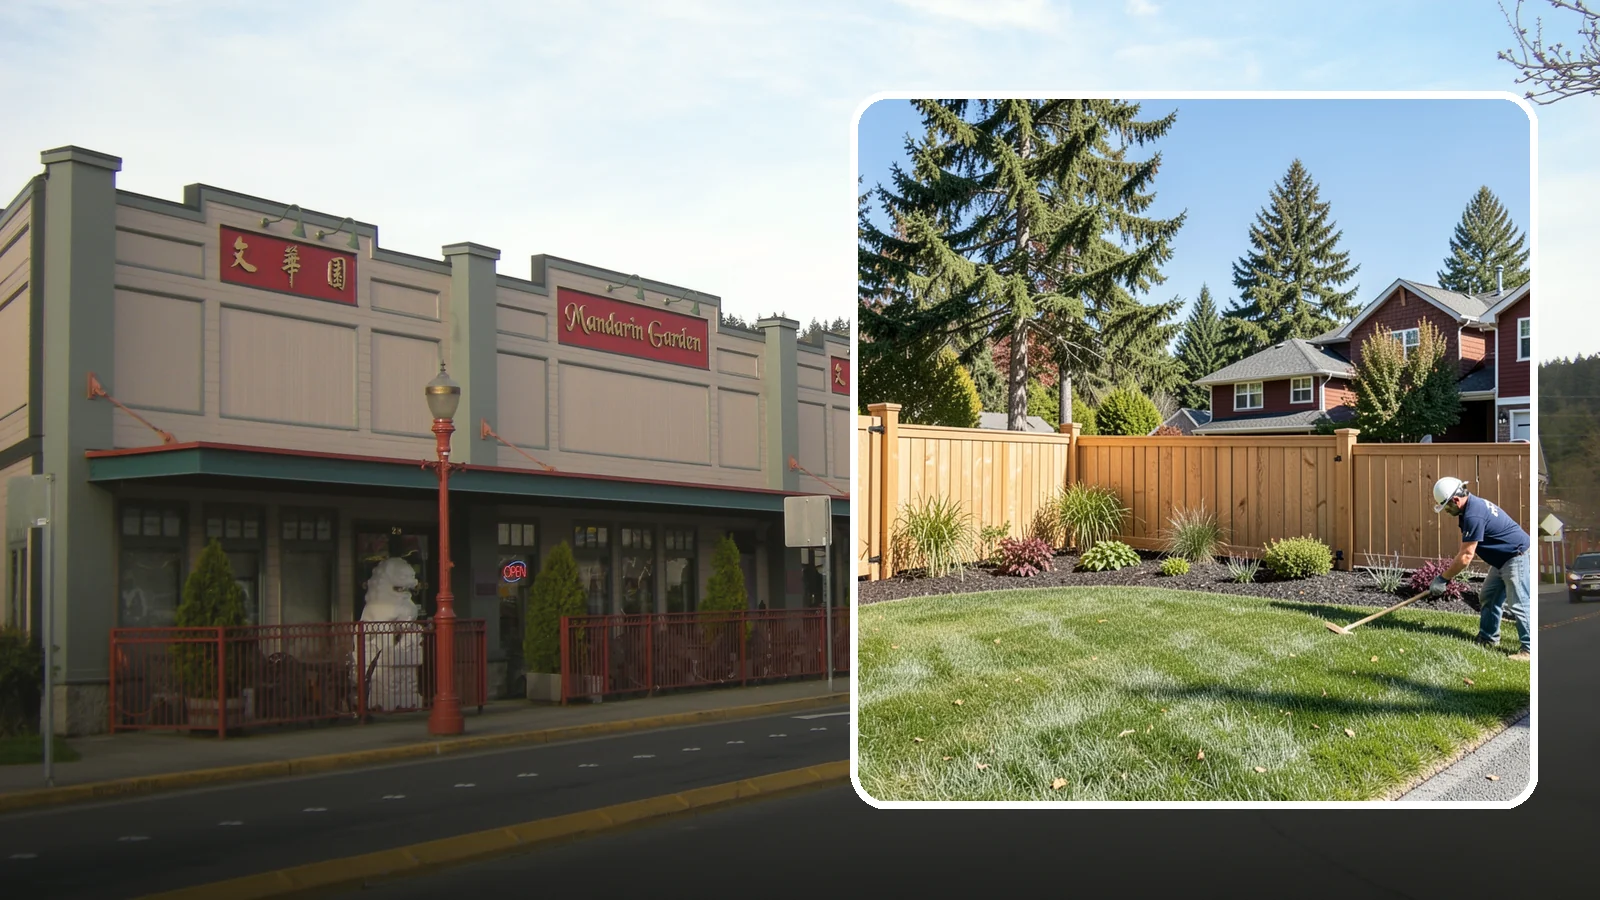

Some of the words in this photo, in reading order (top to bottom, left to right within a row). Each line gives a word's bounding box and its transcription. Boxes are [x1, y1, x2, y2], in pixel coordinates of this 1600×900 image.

[231, 236, 346, 290] 文華園
[565, 302, 644, 341] Mandarin
[648, 320, 701, 352] Garden
[503, 565, 527, 578] OPEN
